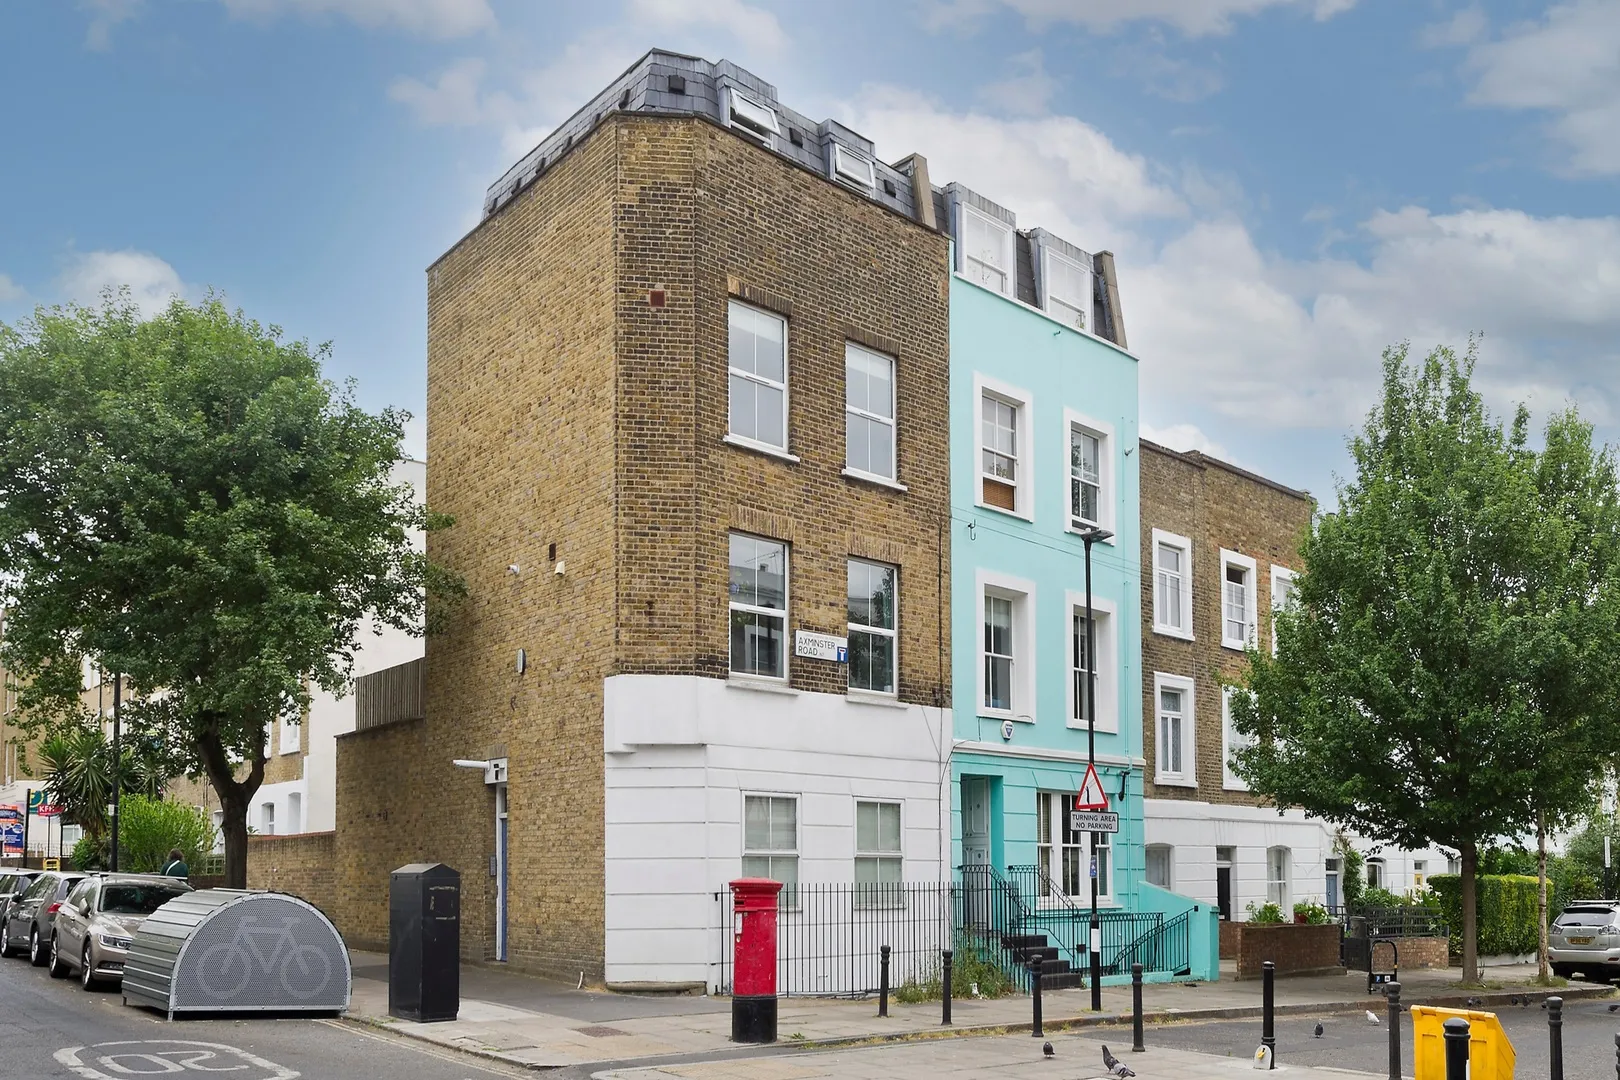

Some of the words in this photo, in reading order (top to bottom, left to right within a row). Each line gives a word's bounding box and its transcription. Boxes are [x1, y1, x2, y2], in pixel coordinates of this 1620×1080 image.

[798, 637, 836, 650] AXMINSTER
[798, 645, 818, 656] ROAD
[1087, 822, 1113, 830] PARKING
